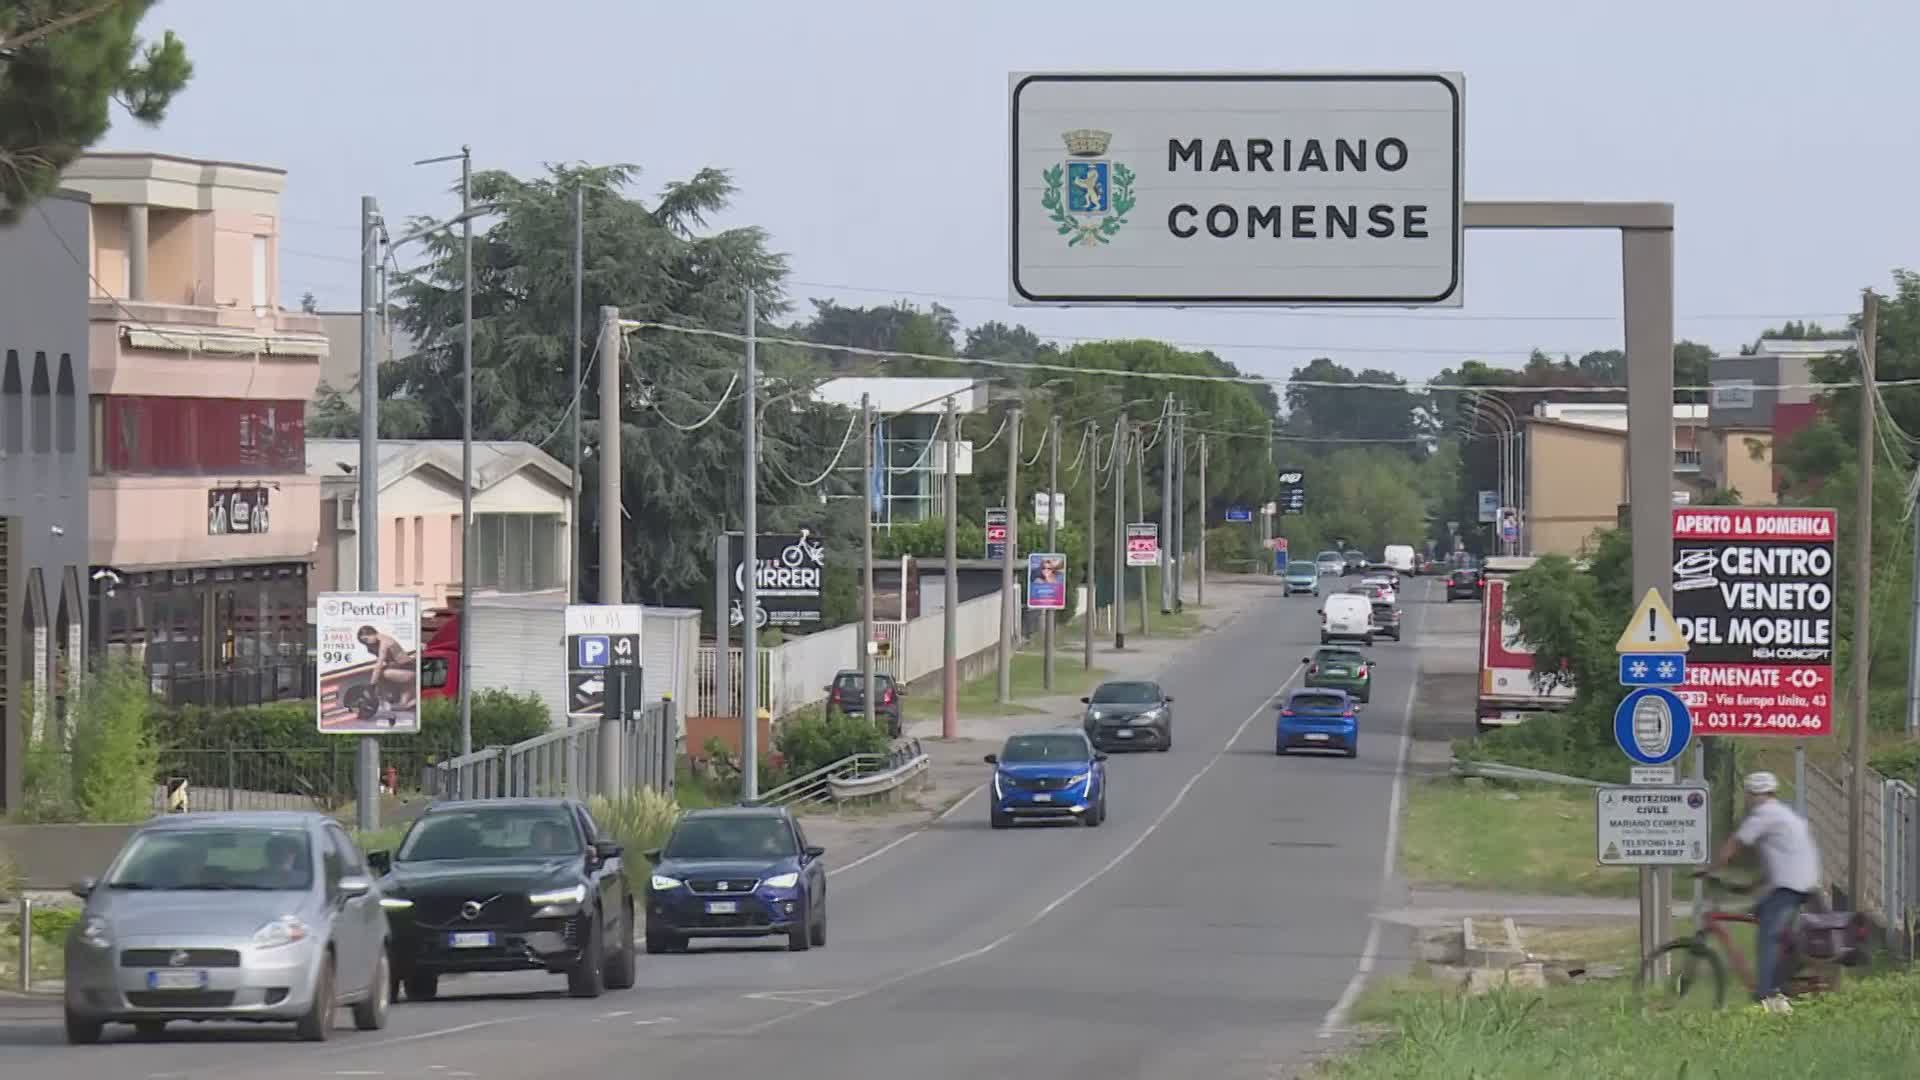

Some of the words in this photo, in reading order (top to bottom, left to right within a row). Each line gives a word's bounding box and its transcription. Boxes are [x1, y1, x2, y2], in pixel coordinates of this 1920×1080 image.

[1168, 137, 1408, 172] MARIANO
[1167, 203, 1429, 238] COMENSE
[1675, 515, 1731, 534] APERTO
[1735, 516, 1752, 534] LA
[1756, 517, 1831, 536] DOMENICA
[1721, 547, 1832, 576] CENTRO
[1720, 582, 1832, 611] VENETO
[1676, 617, 1723, 644] DEL
[1727, 617, 1830, 645] MOBILE
[585, 641, 604, 663] P
[1785, 669, 1824, 689] -CO-
[1715, 694, 1735, 706] Via
[1737, 694, 1775, 708] Europa
[1708, 712, 1822, 729] 031.72.400.46
[1622, 795, 1683, 804] PROTEZIONE
[1636, 806, 1669, 814] CIVILE
[1609, 820, 1651, 828] MARIANO
[1653, 820, 1696, 828] COMENSE
